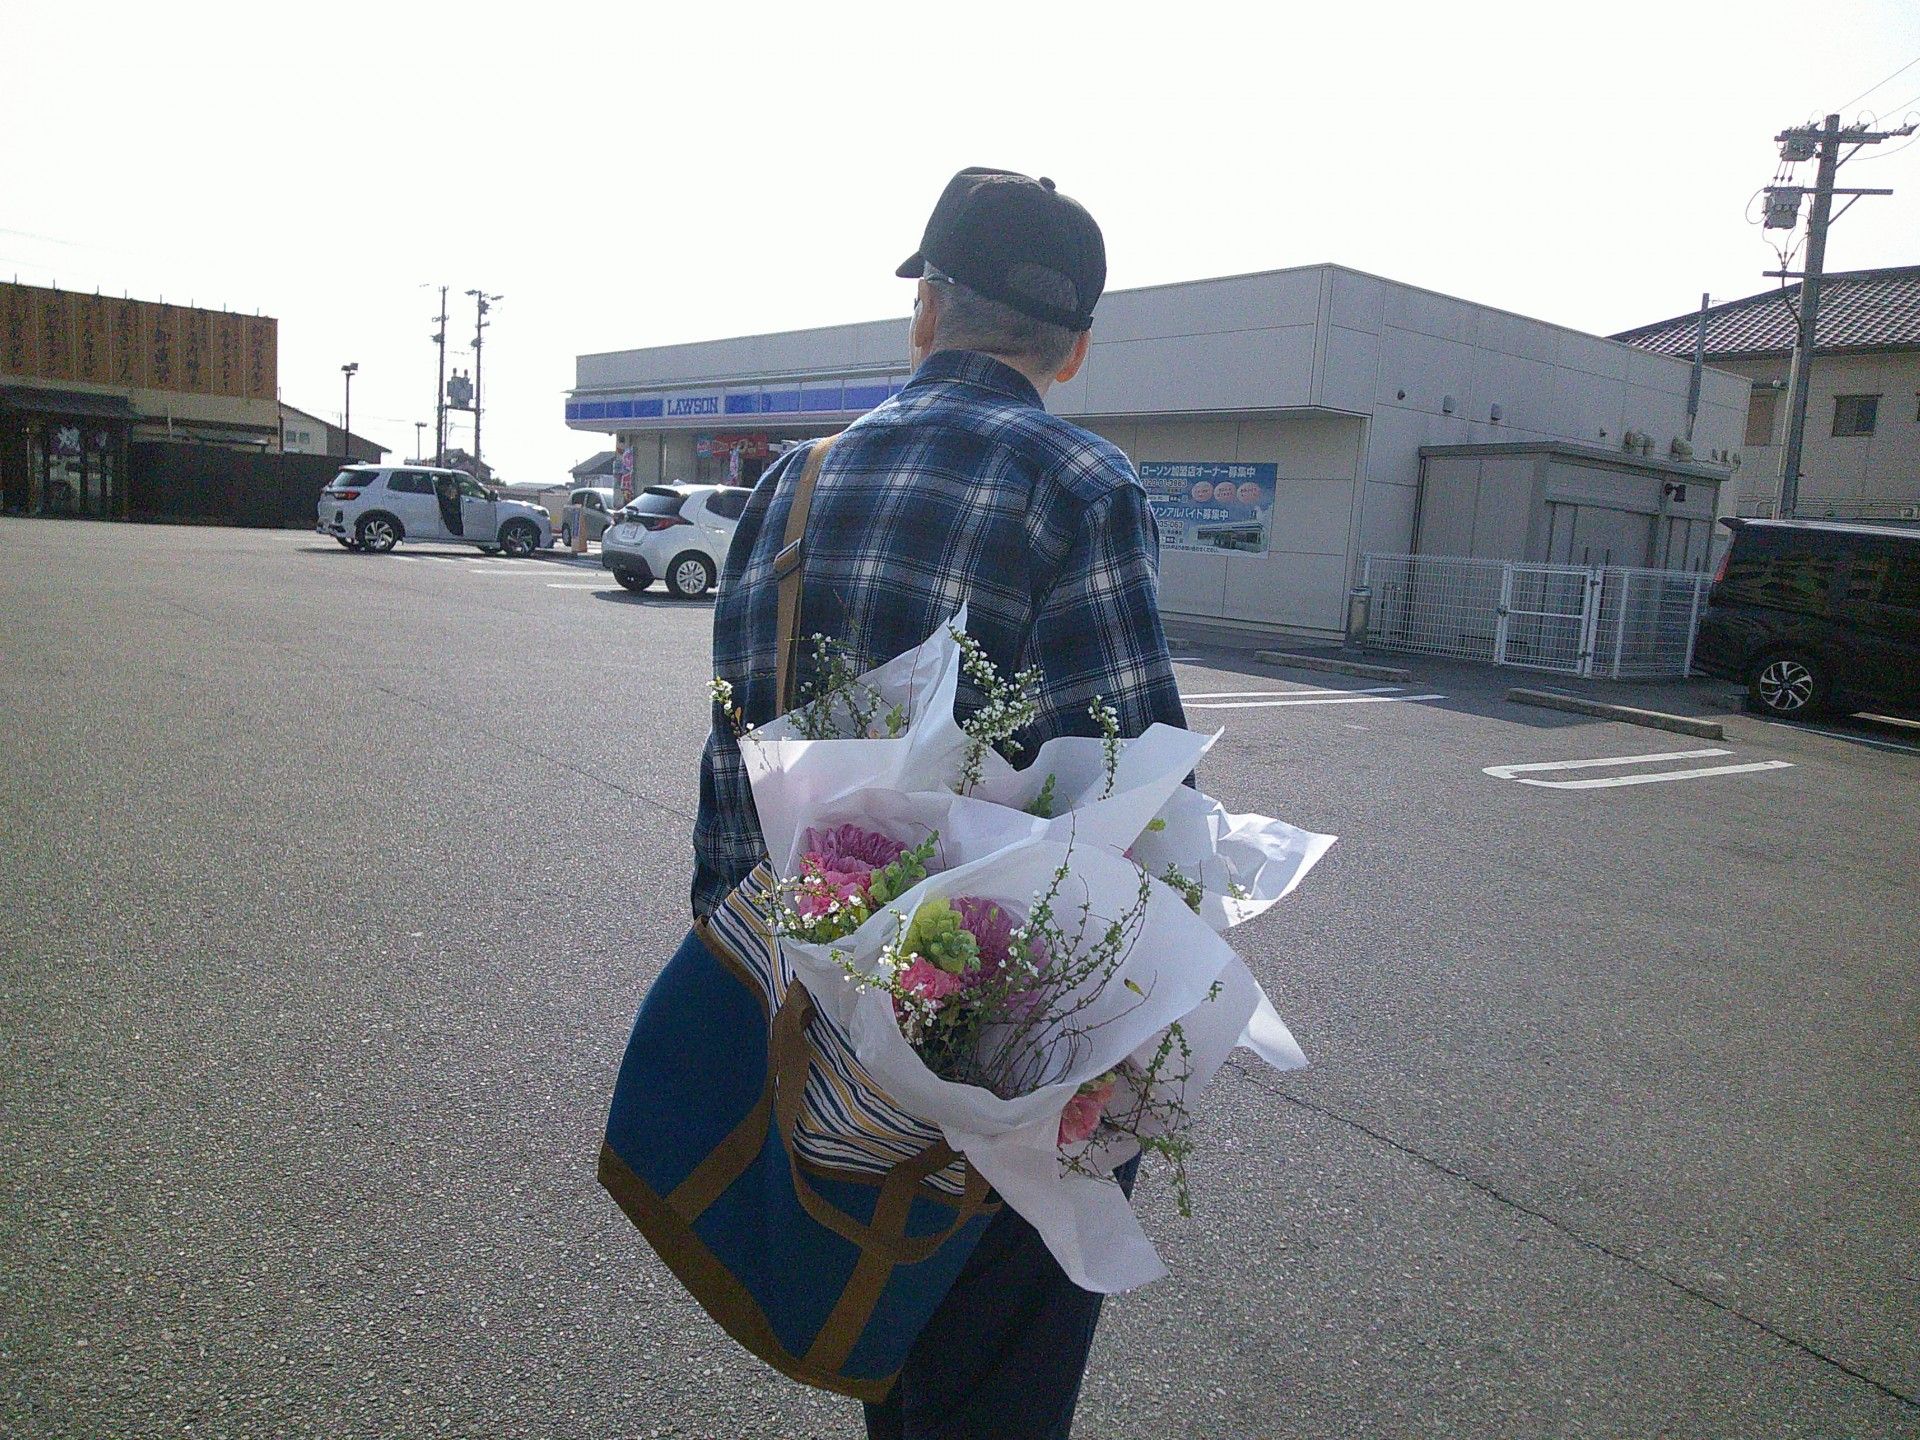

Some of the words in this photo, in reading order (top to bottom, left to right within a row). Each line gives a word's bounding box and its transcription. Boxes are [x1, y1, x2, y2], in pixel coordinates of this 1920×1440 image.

[667, 397, 718, 415] LAWSON
[1141, 465, 1255, 477] ローソン加盟店オーナー募集中
[1154, 507, 1228, 520] ソンアルバイト募集中
